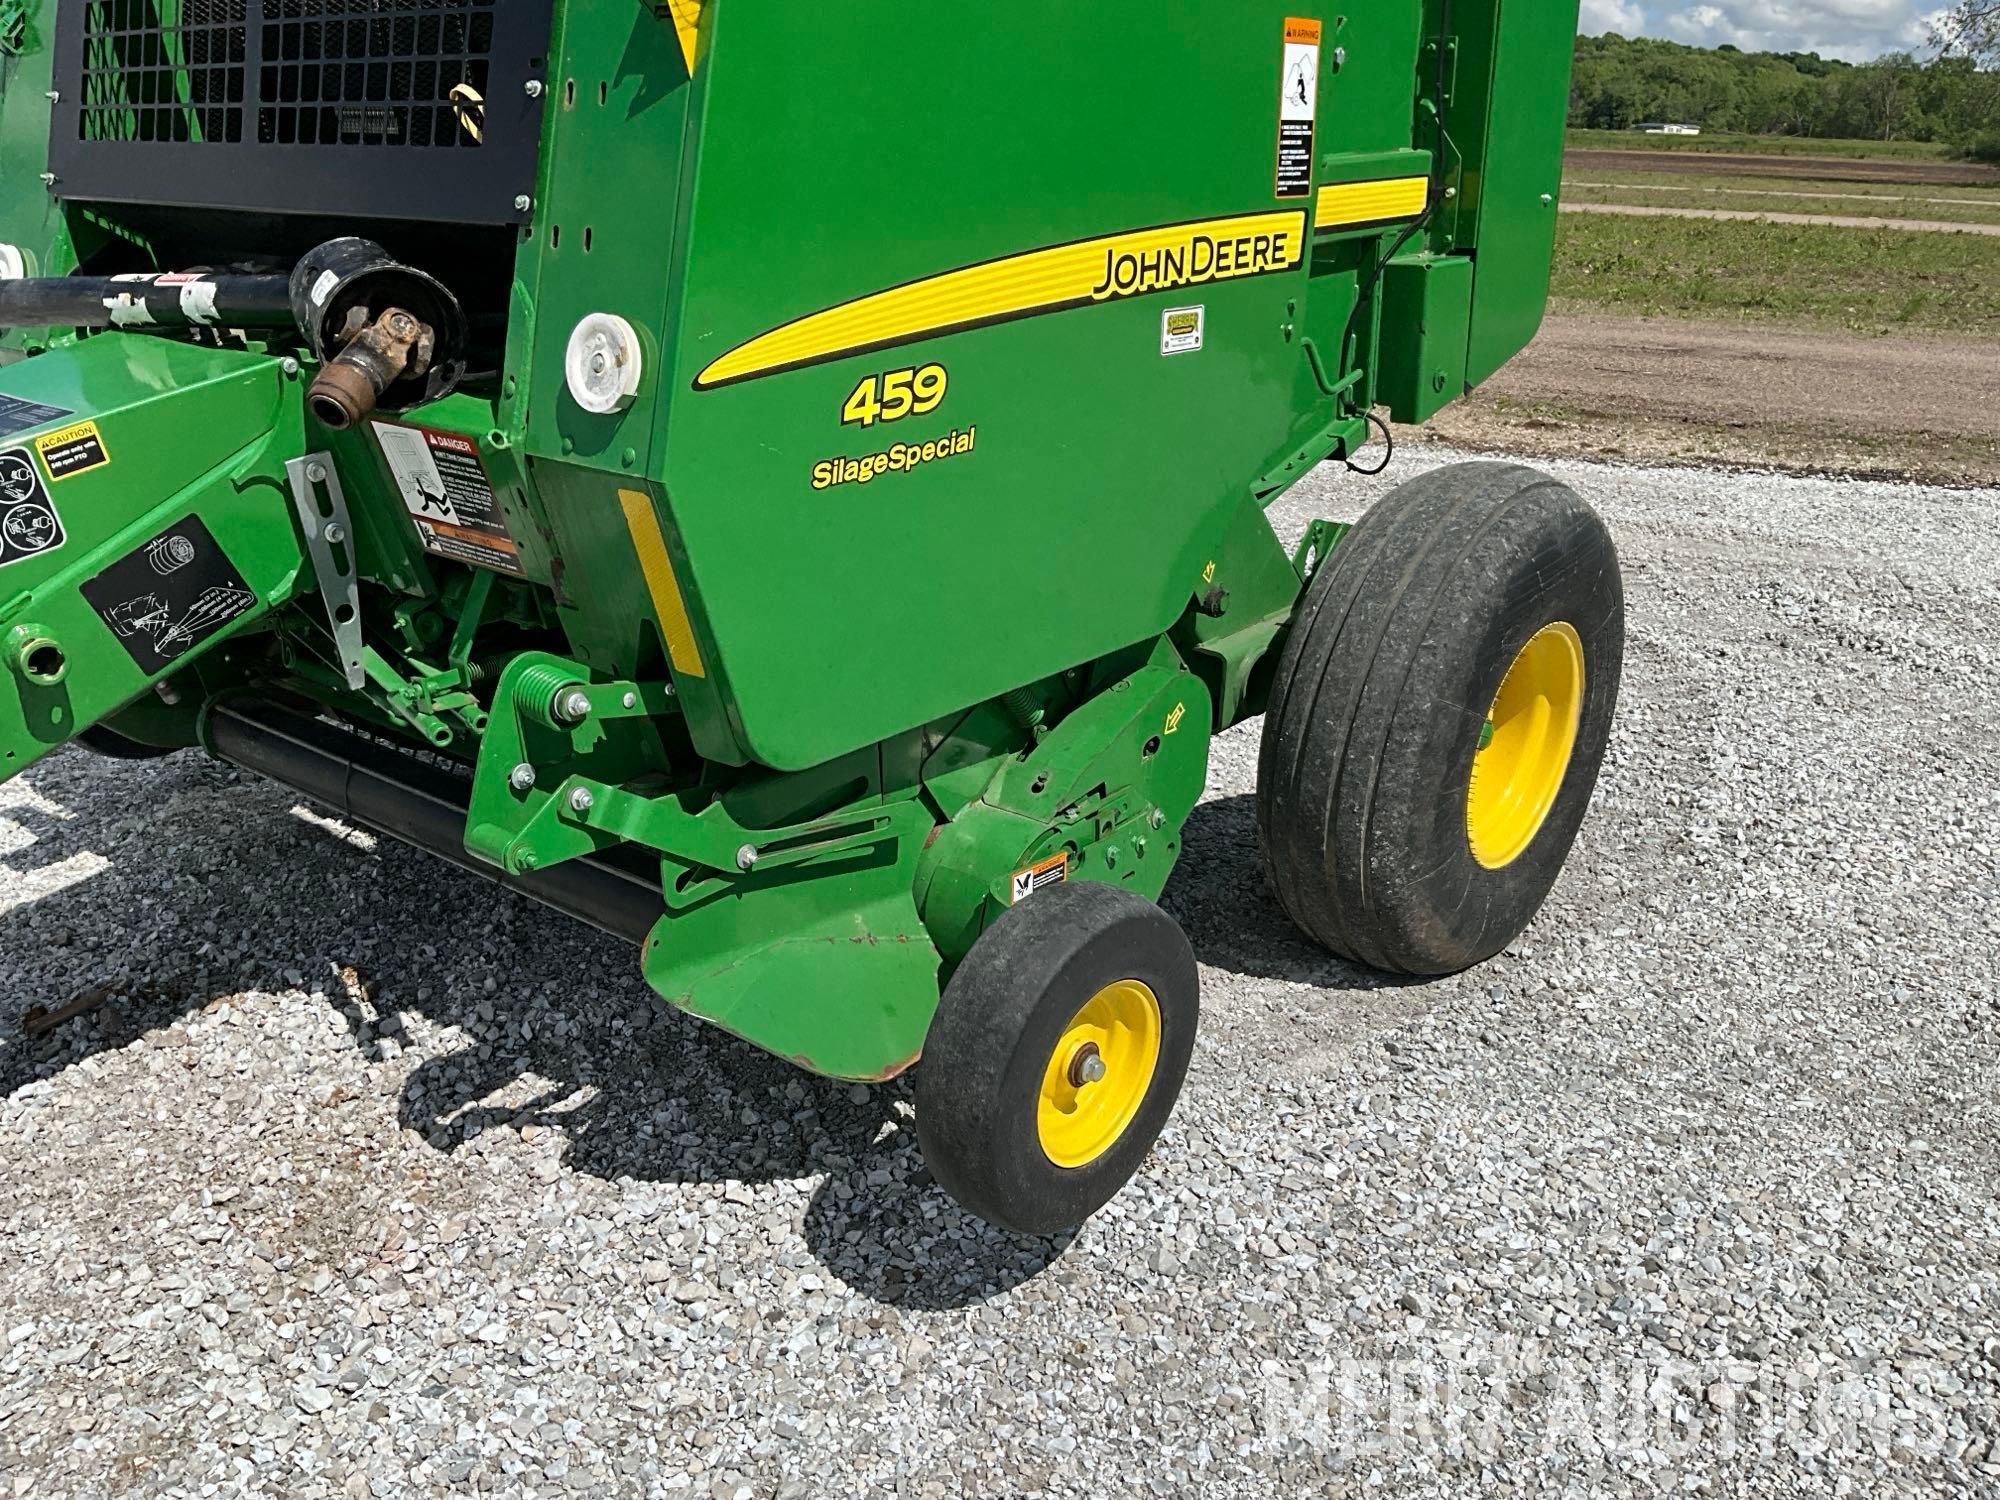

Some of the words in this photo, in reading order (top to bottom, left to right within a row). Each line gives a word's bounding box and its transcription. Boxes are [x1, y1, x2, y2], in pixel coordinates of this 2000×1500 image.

[1092, 247, 1185, 294] JOHN
[1190, 233, 1288, 277] DEERE
[841, 362, 948, 429] 459
[48, 426, 93, 446] CAUTION
[436, 436, 472, 452] DANGER
[74, 452, 88, 461] PTO
[811, 425, 977, 490] SilageSpecial
